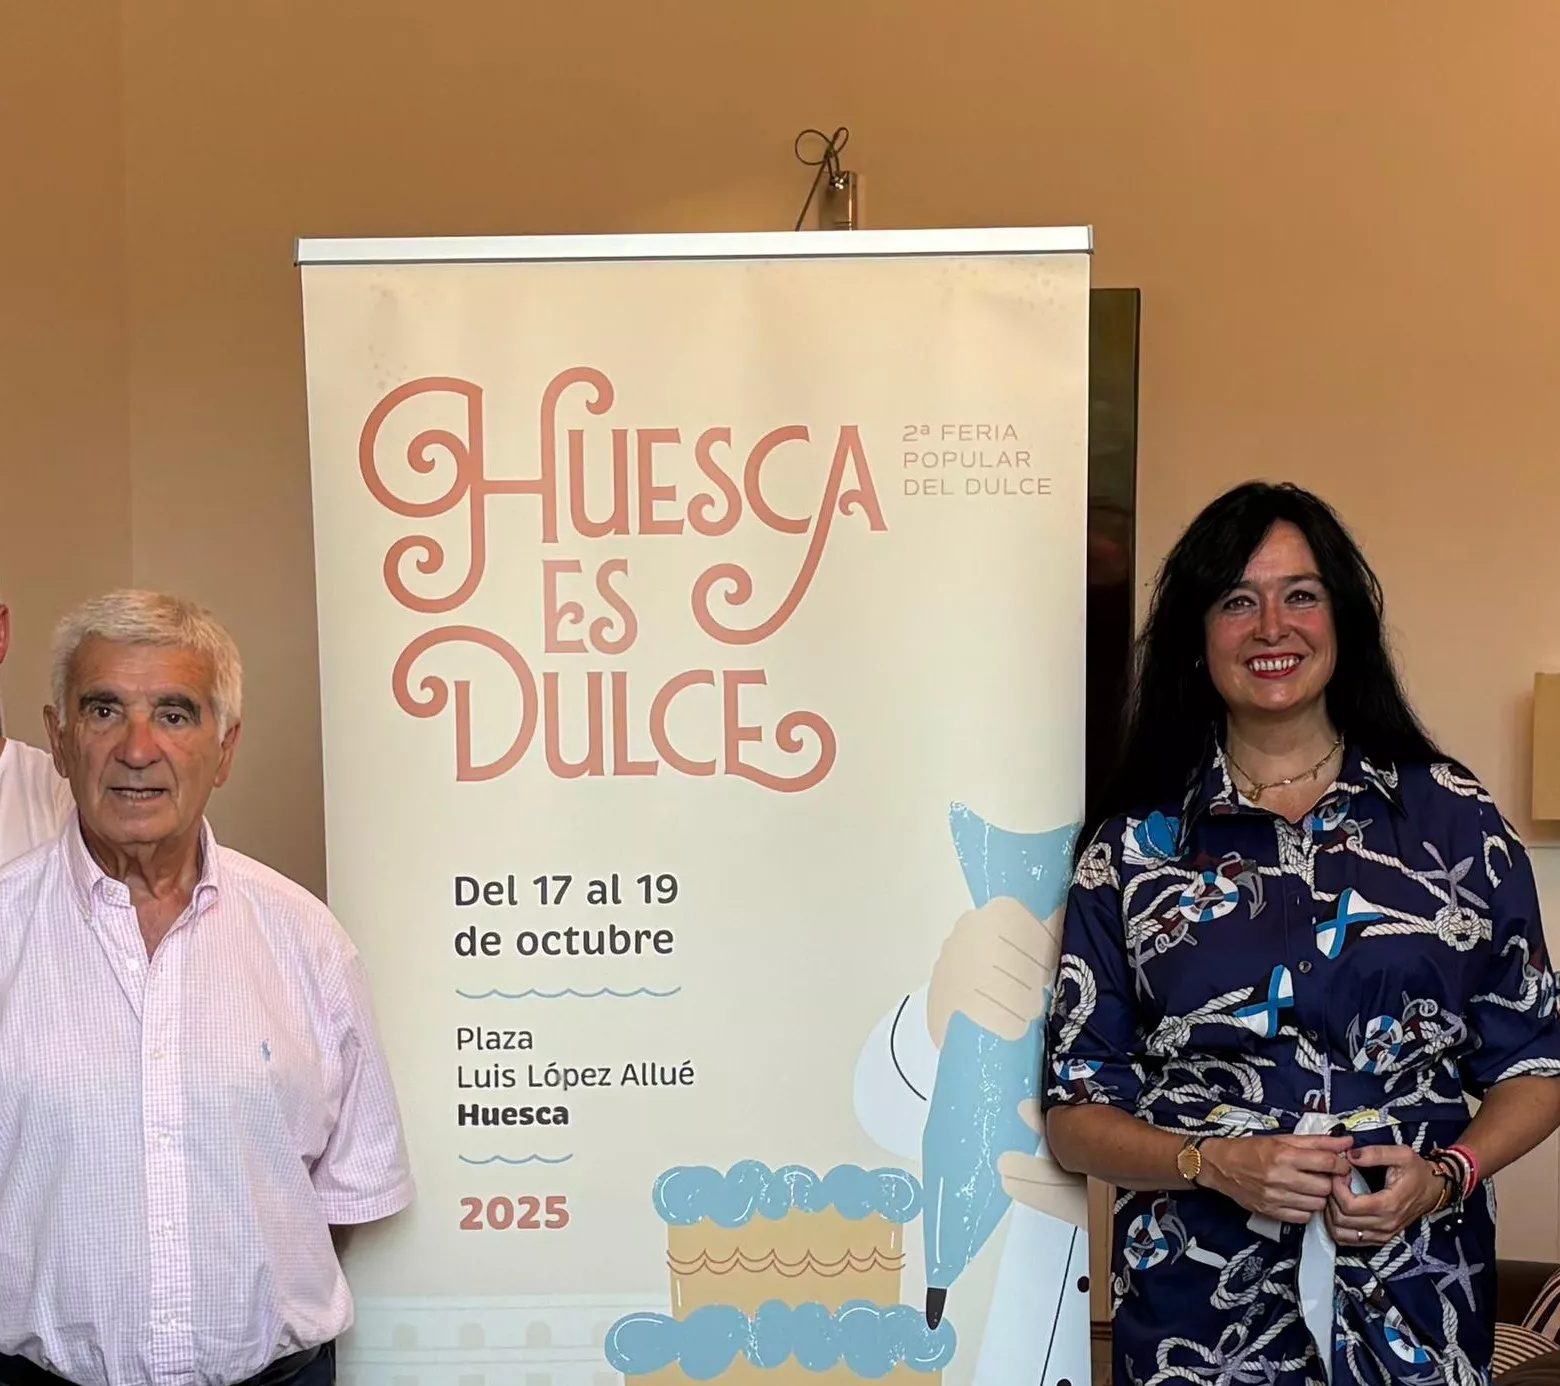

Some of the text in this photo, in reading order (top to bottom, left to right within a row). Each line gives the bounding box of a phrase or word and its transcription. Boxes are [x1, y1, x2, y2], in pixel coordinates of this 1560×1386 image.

[902, 424, 1019, 442] 2ª FERIA
[903, 451, 1032, 469] POPULAR
[904, 477, 1052, 496] DEL DULCE
[359, 366, 888, 644] HUESCA
[542, 559, 638, 655] ES
[392, 625, 837, 793] DULCE
[454, 873, 679, 906] Del 17 al 19
[454, 924, 674, 957] de octubre
[456, 1026, 534, 1050] Plaza
[457, 1059, 696, 1091] Luis López Allué
[457, 1103, 570, 1127] Huesca
[459, 1195, 571, 1231] 2025
